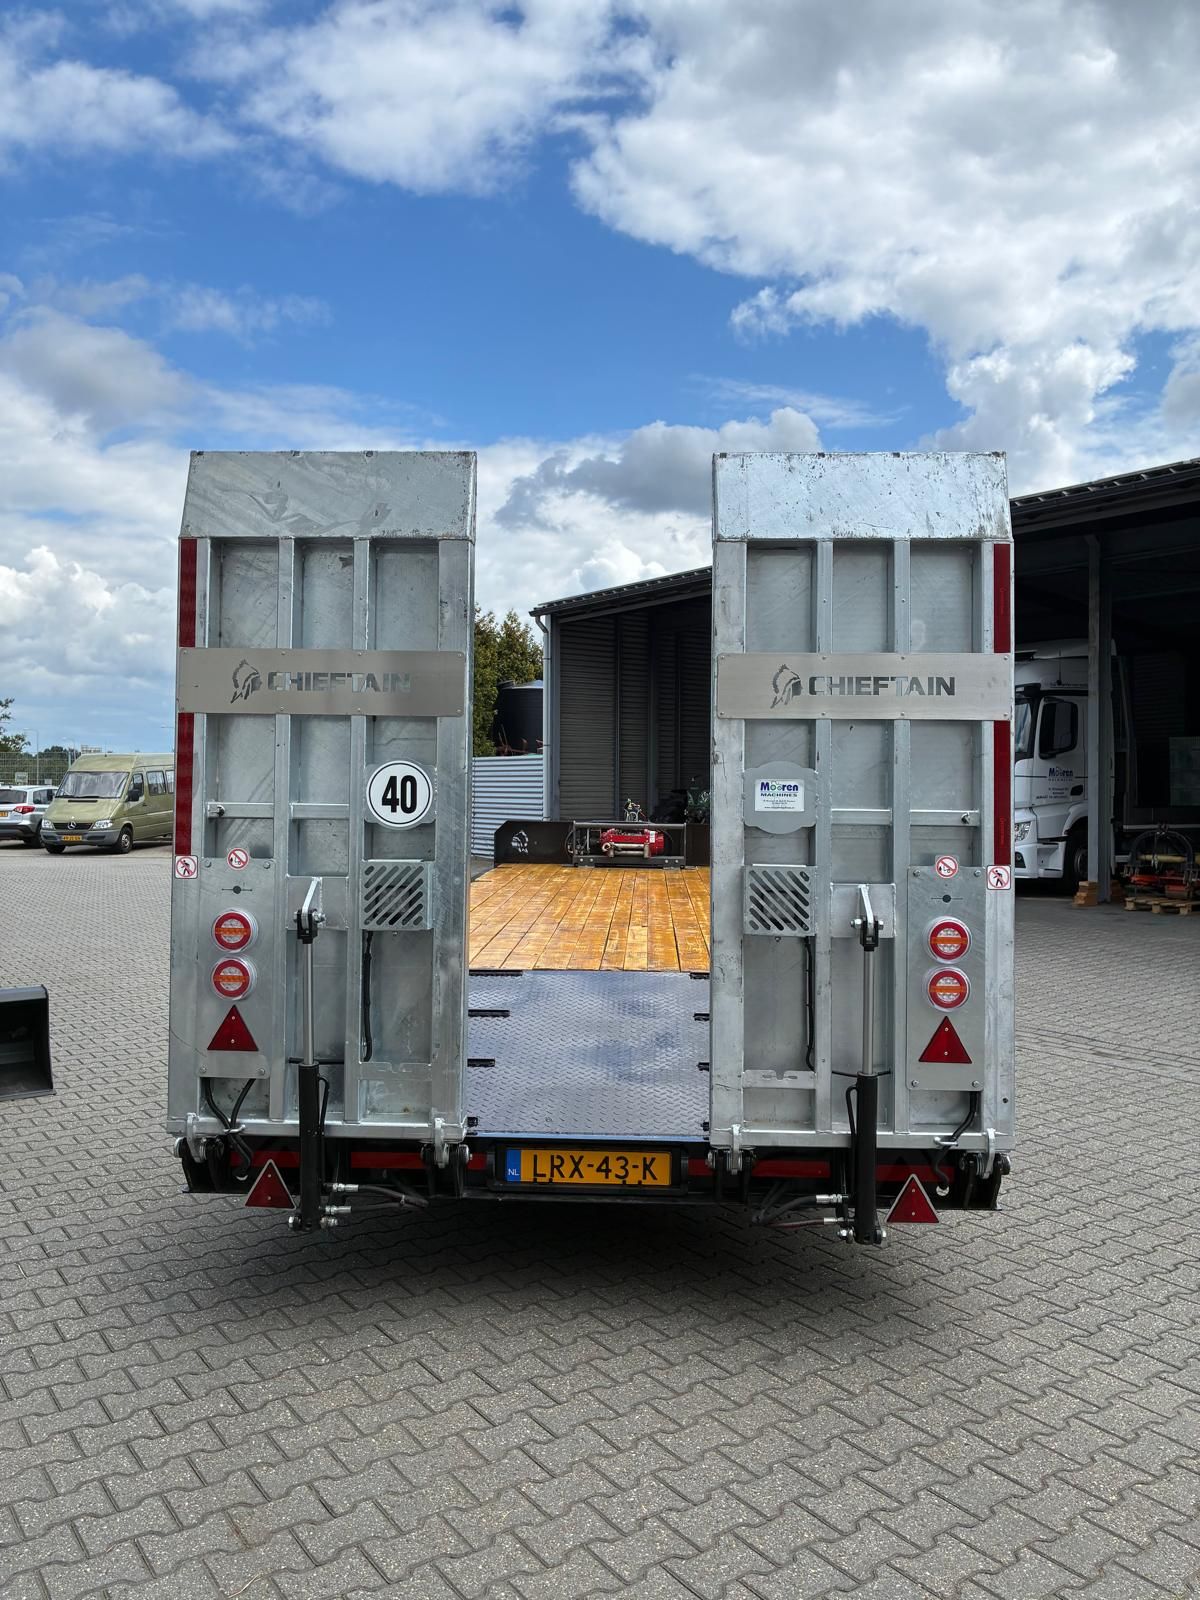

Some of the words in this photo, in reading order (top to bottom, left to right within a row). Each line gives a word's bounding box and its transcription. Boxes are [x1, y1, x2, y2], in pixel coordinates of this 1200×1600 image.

[267, 671, 411, 693] CHIEFTAIN
[808, 676, 956, 697] CHIEFTAIN
[381, 775, 418, 814] 40
[760, 781, 799, 791] Mooren
[507, 1168, 520, 1177] NL
[532, 1154, 658, 1181] LRX-43-K
